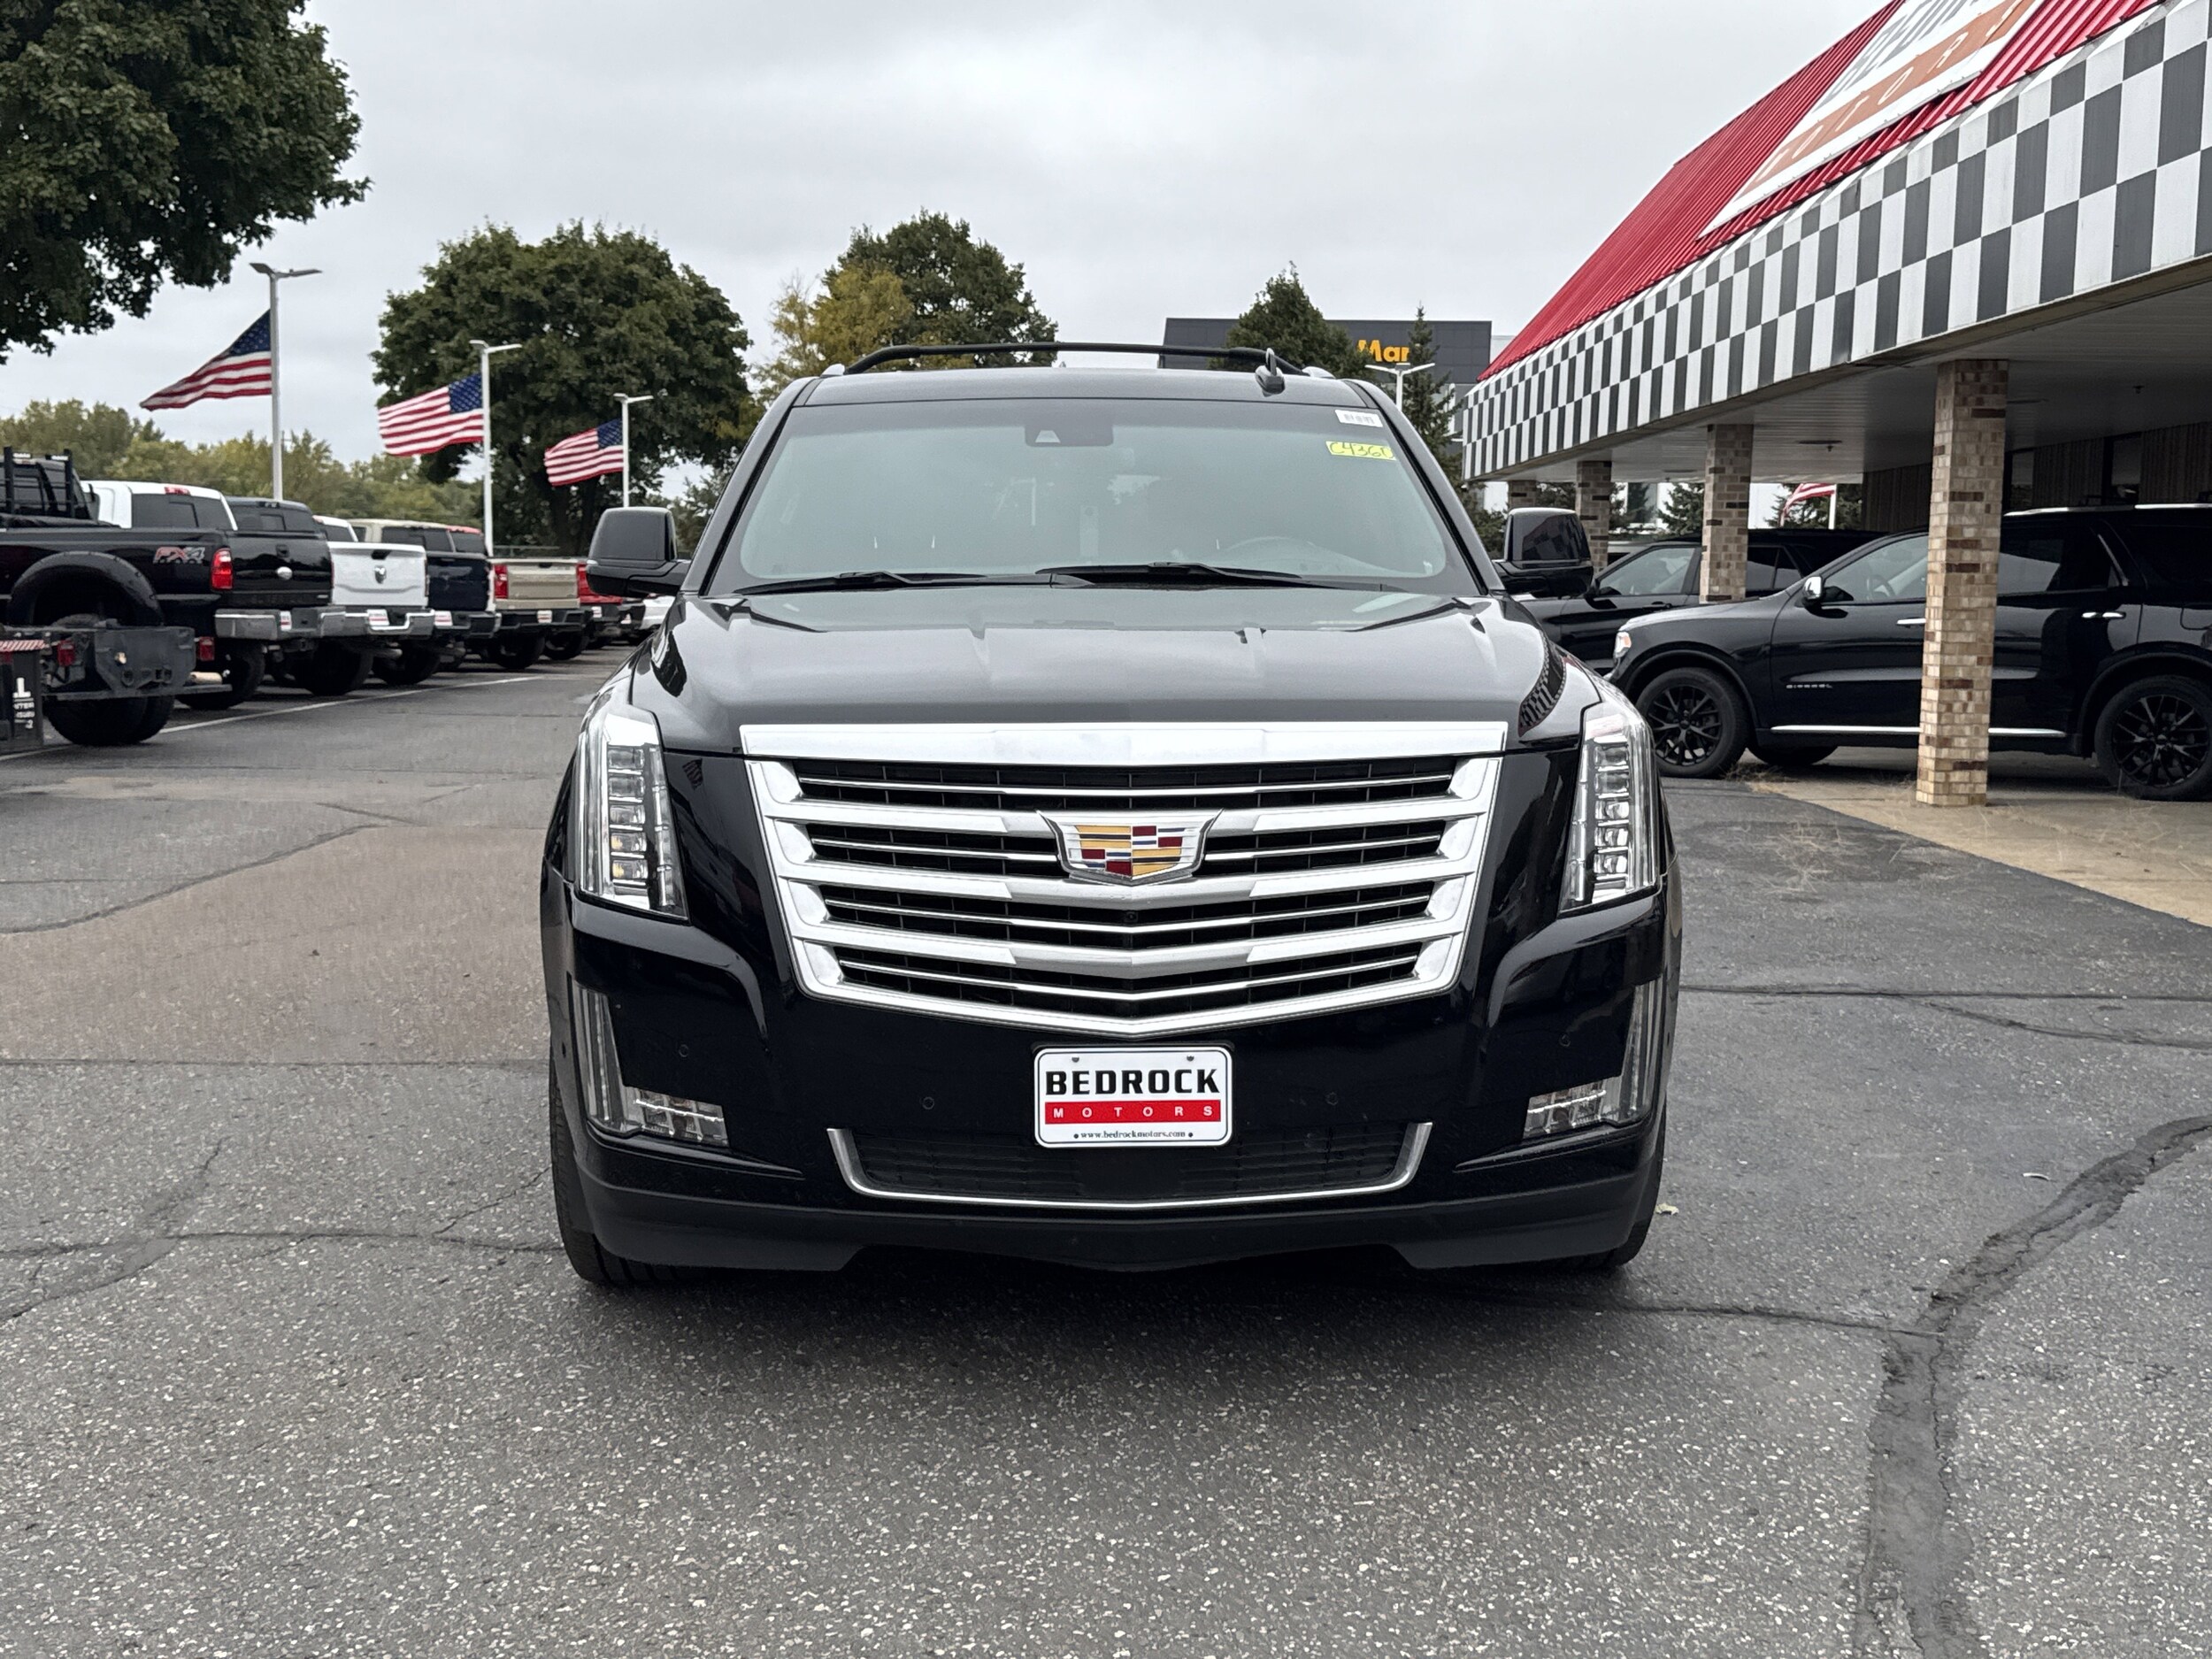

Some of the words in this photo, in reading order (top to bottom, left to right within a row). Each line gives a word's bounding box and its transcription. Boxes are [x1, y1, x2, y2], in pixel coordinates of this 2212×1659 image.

[1046, 1069, 1220, 1095] BEDROCK
[1053, 1106, 1213, 1118] MOTORS
[1080, 1130, 1186, 1139] www.bedrockmotors.com
